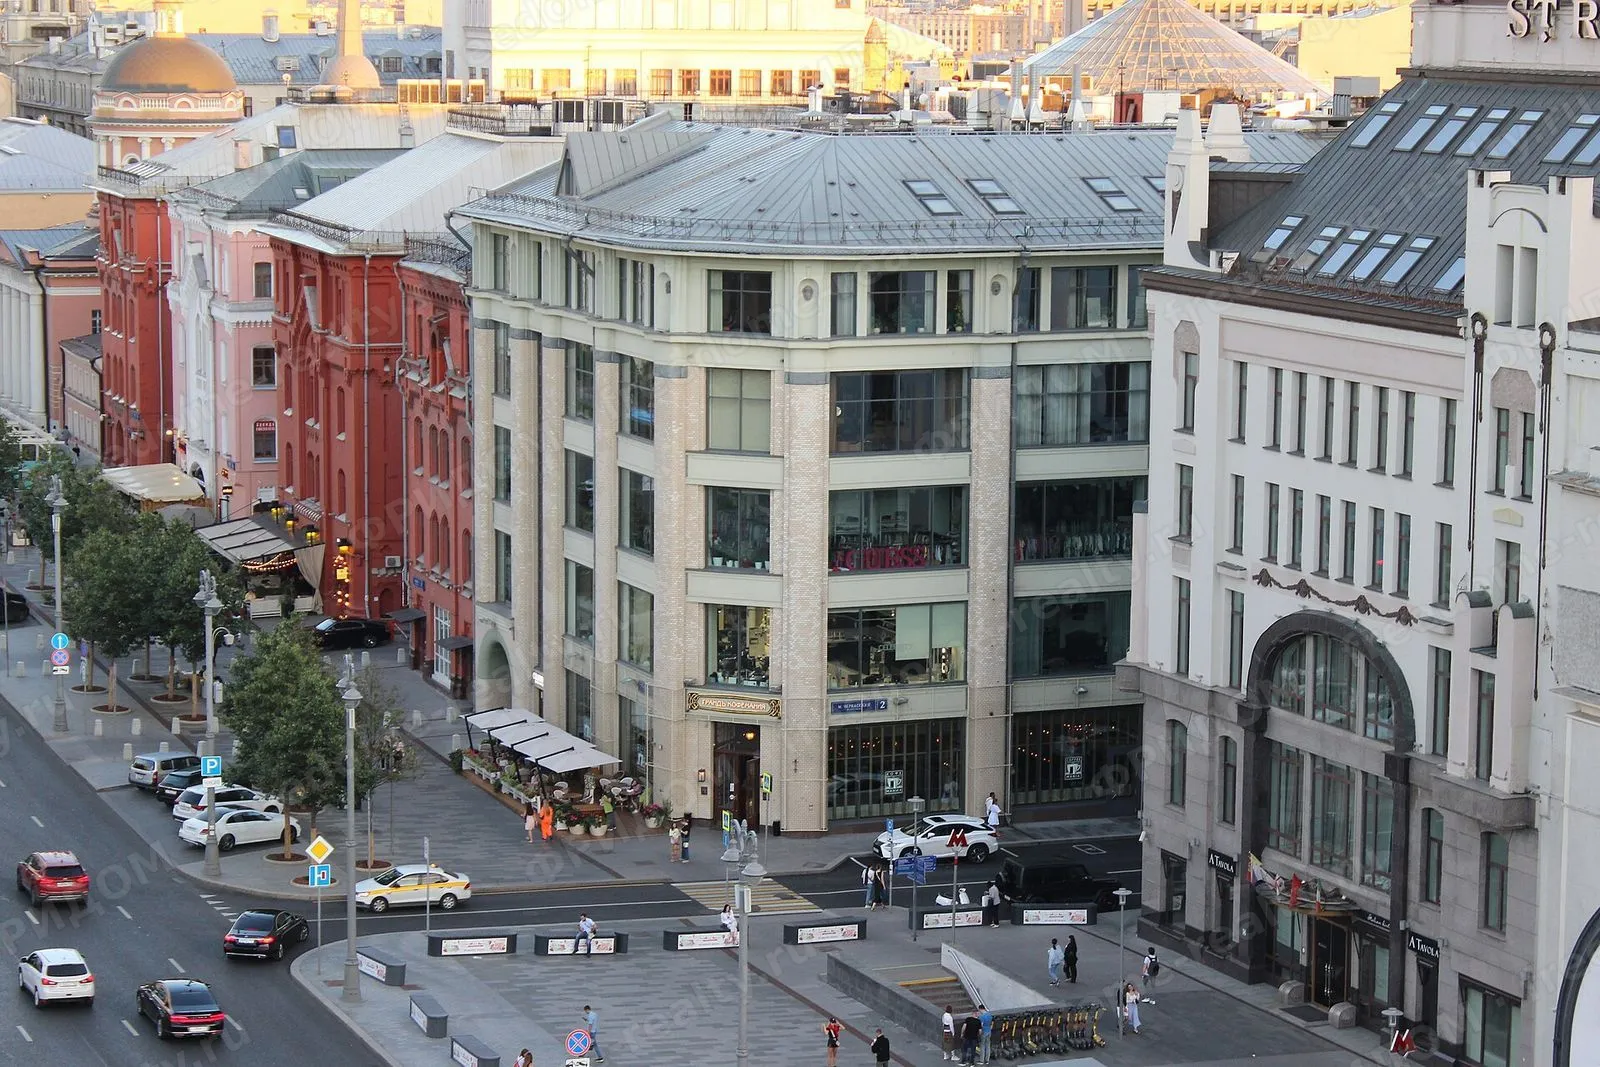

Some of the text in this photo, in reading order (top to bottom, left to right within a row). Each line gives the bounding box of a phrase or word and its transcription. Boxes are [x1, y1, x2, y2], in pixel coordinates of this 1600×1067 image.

[879, 700, 886, 709] 2
[206, 758, 218, 774] P
[1408, 936, 1415, 949] A
